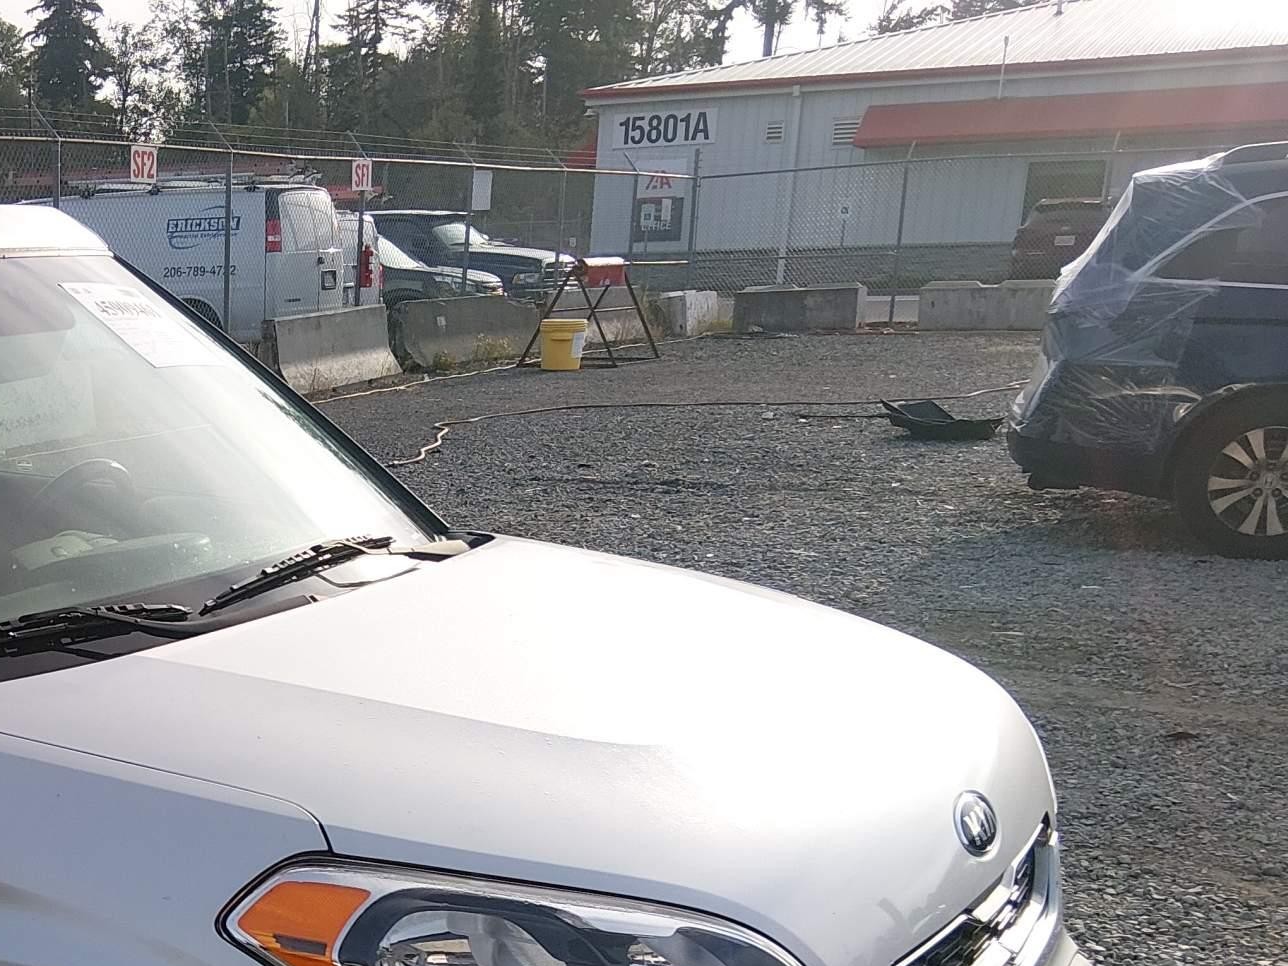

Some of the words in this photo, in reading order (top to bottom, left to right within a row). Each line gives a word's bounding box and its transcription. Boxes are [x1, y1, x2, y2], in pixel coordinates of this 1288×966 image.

[619, 111, 710, 145] 15801A
[132, 149, 155, 179] SF2
[355, 162, 370, 188] SF1
[163, 264, 237, 278] 206-789-472
